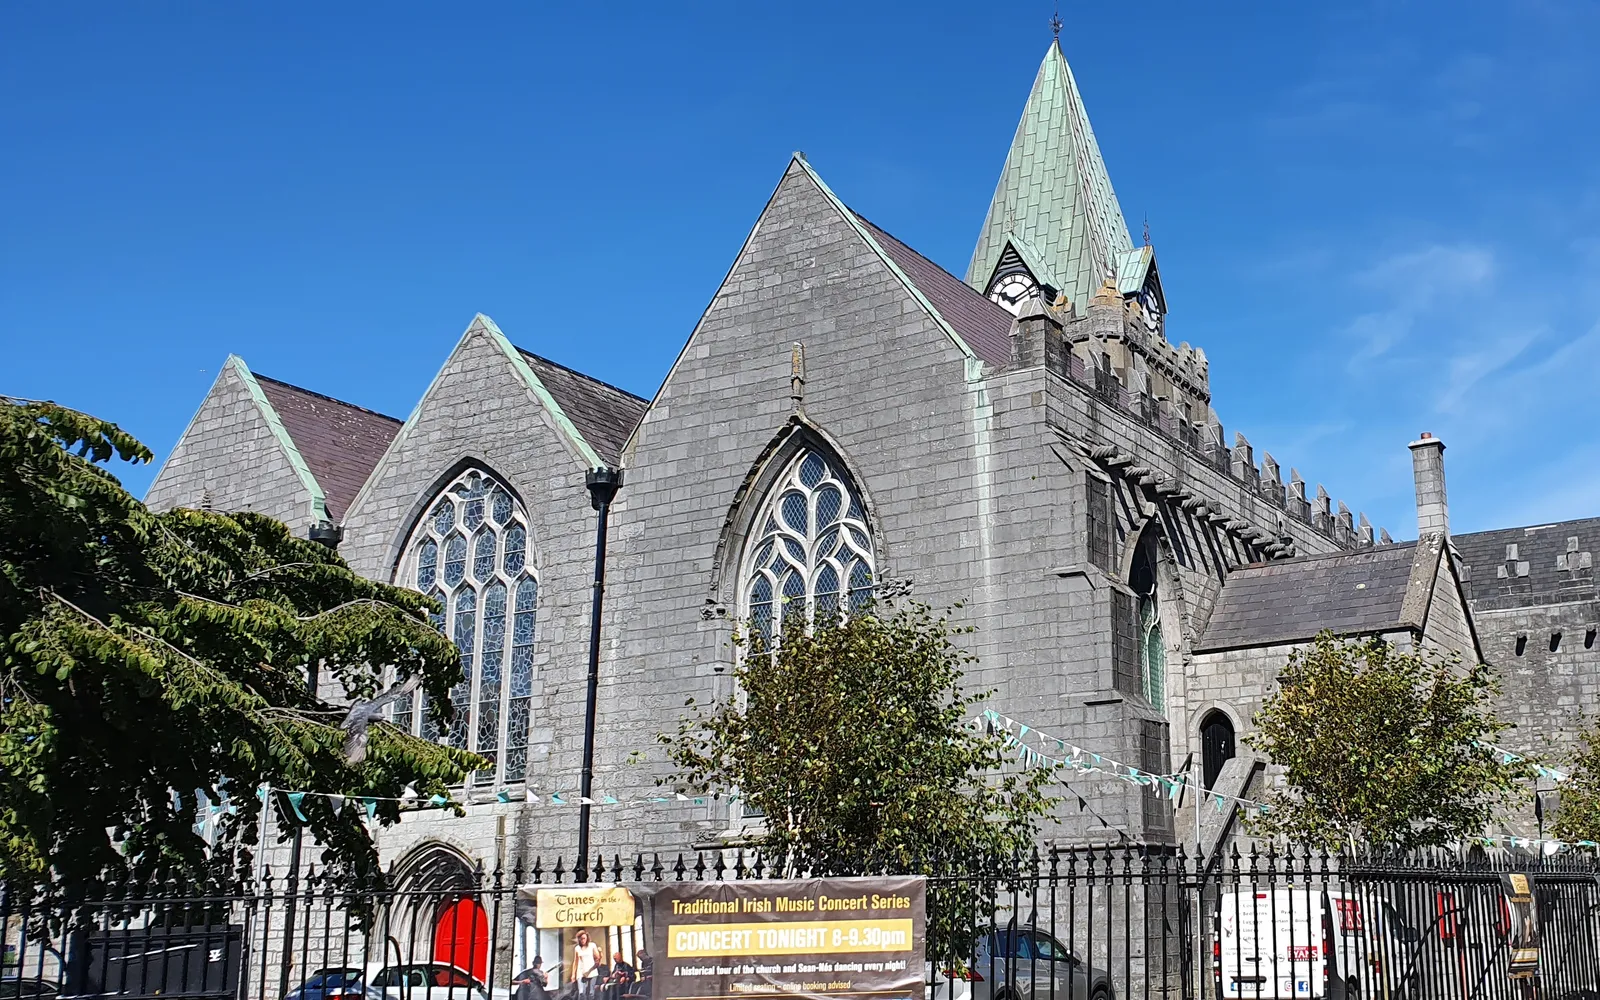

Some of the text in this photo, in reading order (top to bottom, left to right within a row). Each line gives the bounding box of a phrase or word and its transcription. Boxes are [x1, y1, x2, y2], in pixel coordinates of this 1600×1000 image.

[555, 894, 595, 906] Tunes
[608, 896, 617, 904] the
[672, 894, 911, 915] Traditional Irish Music Concert Series
[555, 907, 604, 924] Church
[676, 927, 906, 951] CONCERT TONIGHT 8-9.30pm
[674, 960, 906, 976] A historical tour of the church and Sean-Nós dancing every night!
[729, 980, 851, 992] Limited seating online booking advised
